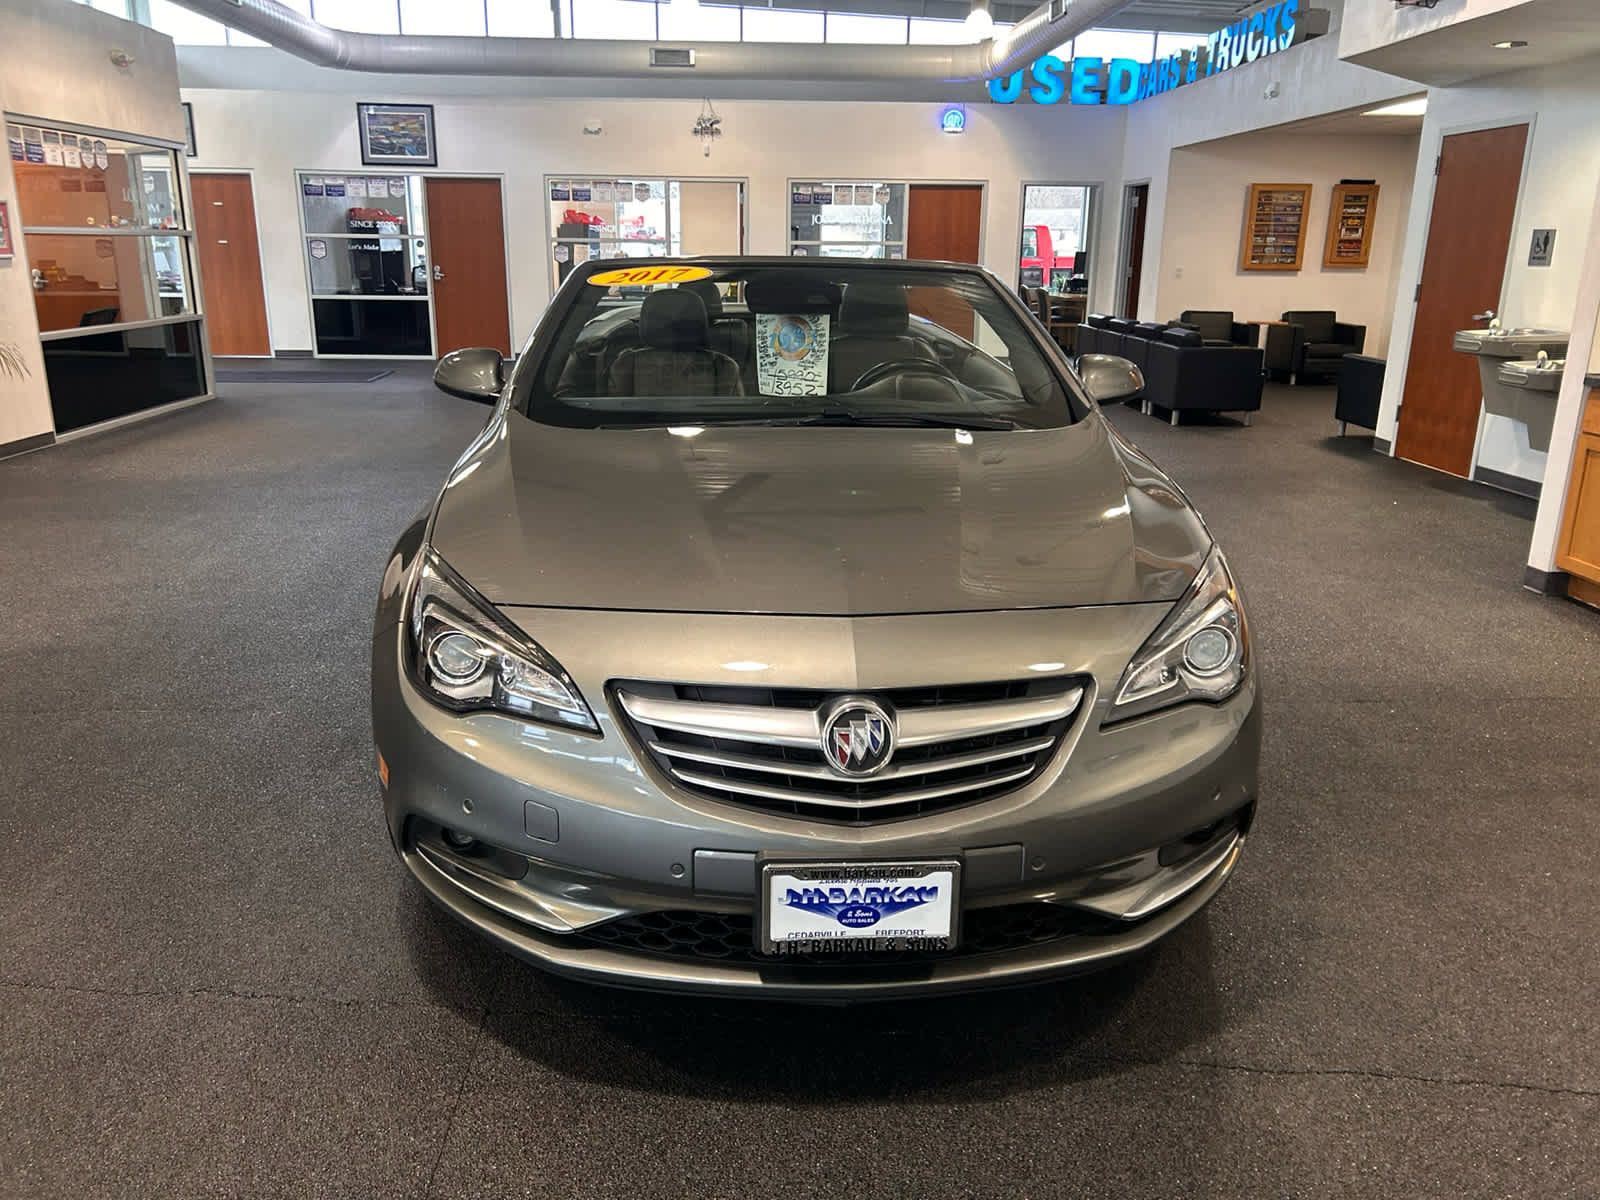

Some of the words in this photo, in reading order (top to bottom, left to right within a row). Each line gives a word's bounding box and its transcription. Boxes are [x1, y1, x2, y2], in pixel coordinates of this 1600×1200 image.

[988, 55, 1140, 105] USED
[1139, 50, 1181, 100] CARS
[1187, 49, 1199, 83] &
[1206, 0, 1299, 76] TRUCKS
[350, 220, 374, 228] SINCE
[607, 268, 693, 284] 2017
[811, 867, 915, 879] www.barkau.com
[788, 931, 847, 940] CEDARVILLE
[875, 929, 926, 937] FREEPORT
[812, 937, 877, 953] BARKAU
[885, 937, 897, 952] &
[905, 937, 949, 952] SONS
